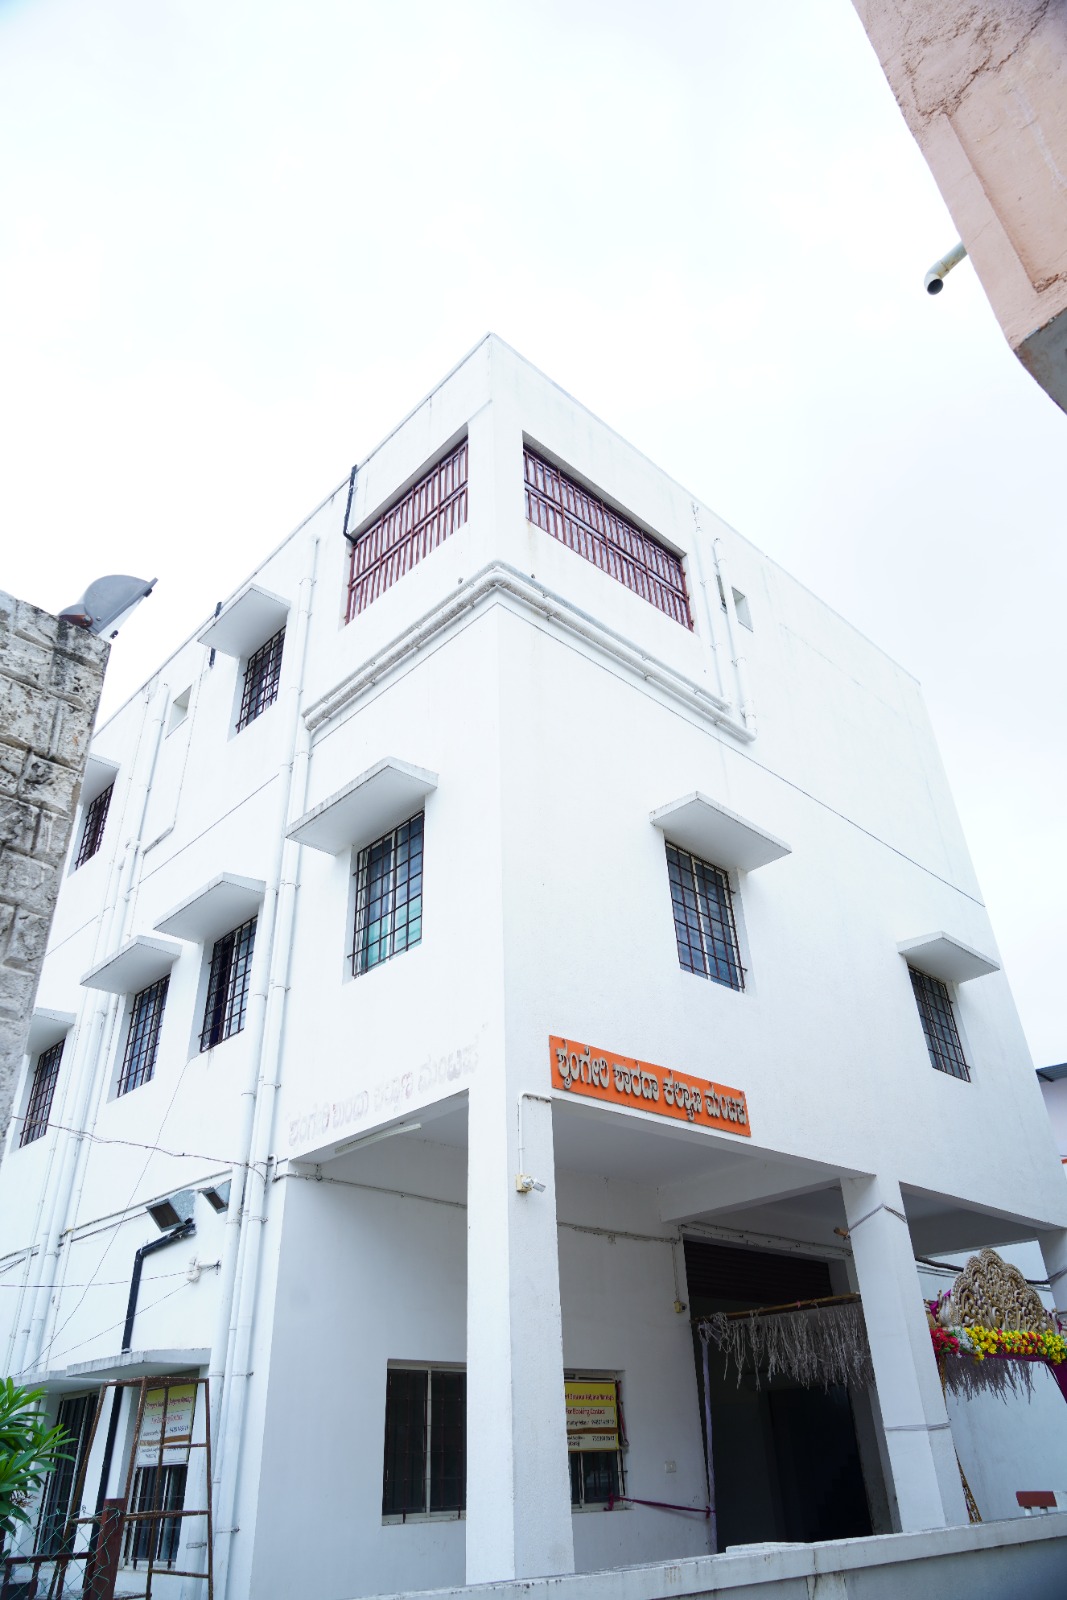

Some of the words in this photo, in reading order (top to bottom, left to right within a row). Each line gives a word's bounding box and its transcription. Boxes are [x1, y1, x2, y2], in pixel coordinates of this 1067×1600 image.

[556, 1040, 610, 1089] ಶೃಂಗೇರಿ
[613, 1060, 660, 1101] ಶಾರದಾ
[663, 1070, 703, 1121] ಕಲ್ಯಾಣ
[704, 1082, 747, 1125] ಮಂಟಪ
